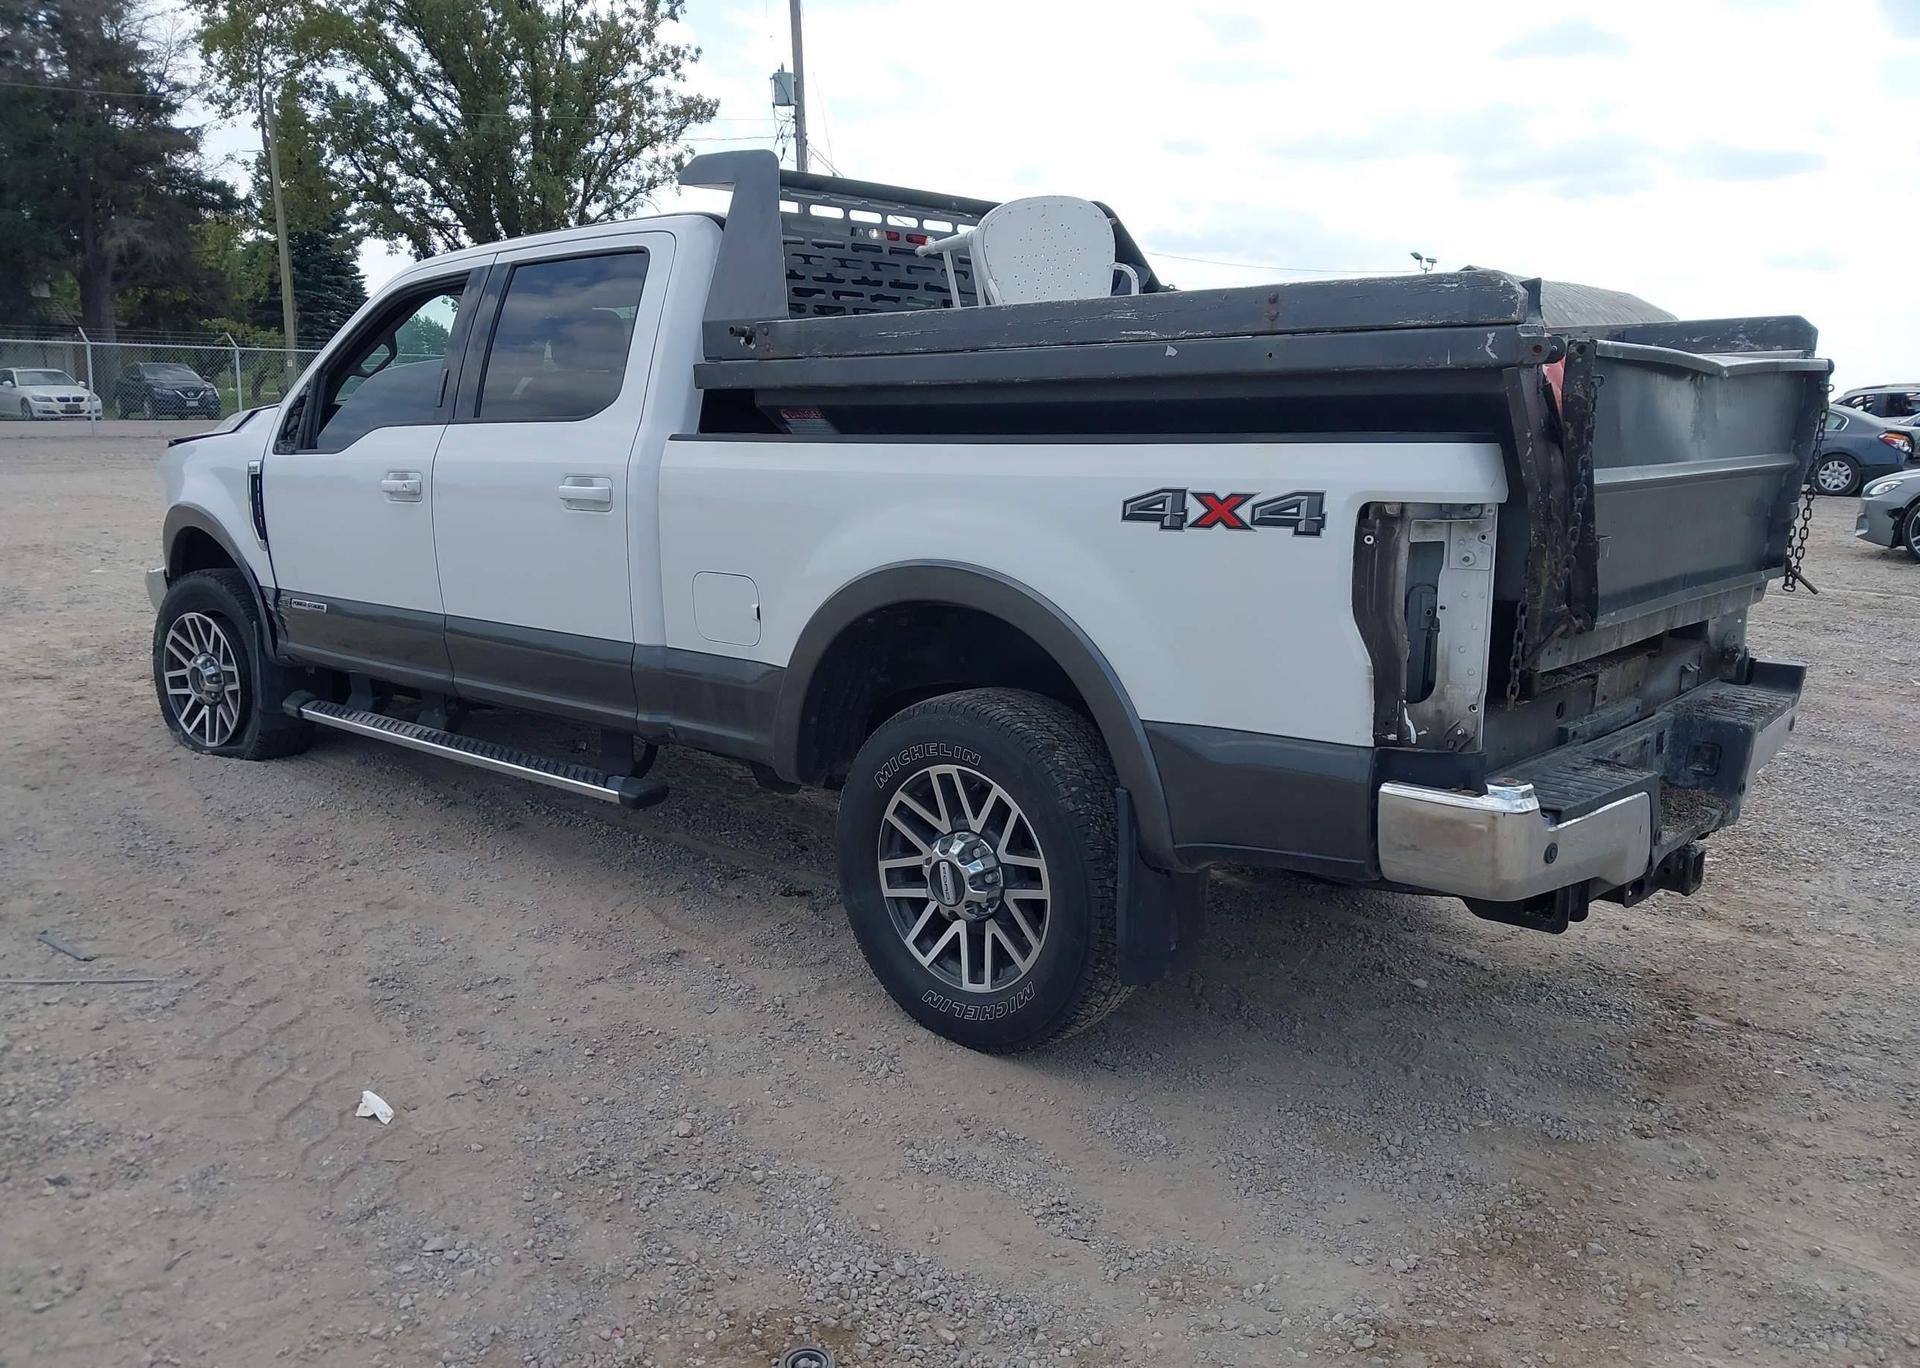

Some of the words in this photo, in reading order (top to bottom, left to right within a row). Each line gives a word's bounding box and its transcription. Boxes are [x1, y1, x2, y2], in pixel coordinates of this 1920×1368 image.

[1121, 487, 1328, 538] 4X4
[874, 743, 982, 788] MICHELIN
[922, 981, 1035, 1021] MICHELIN
